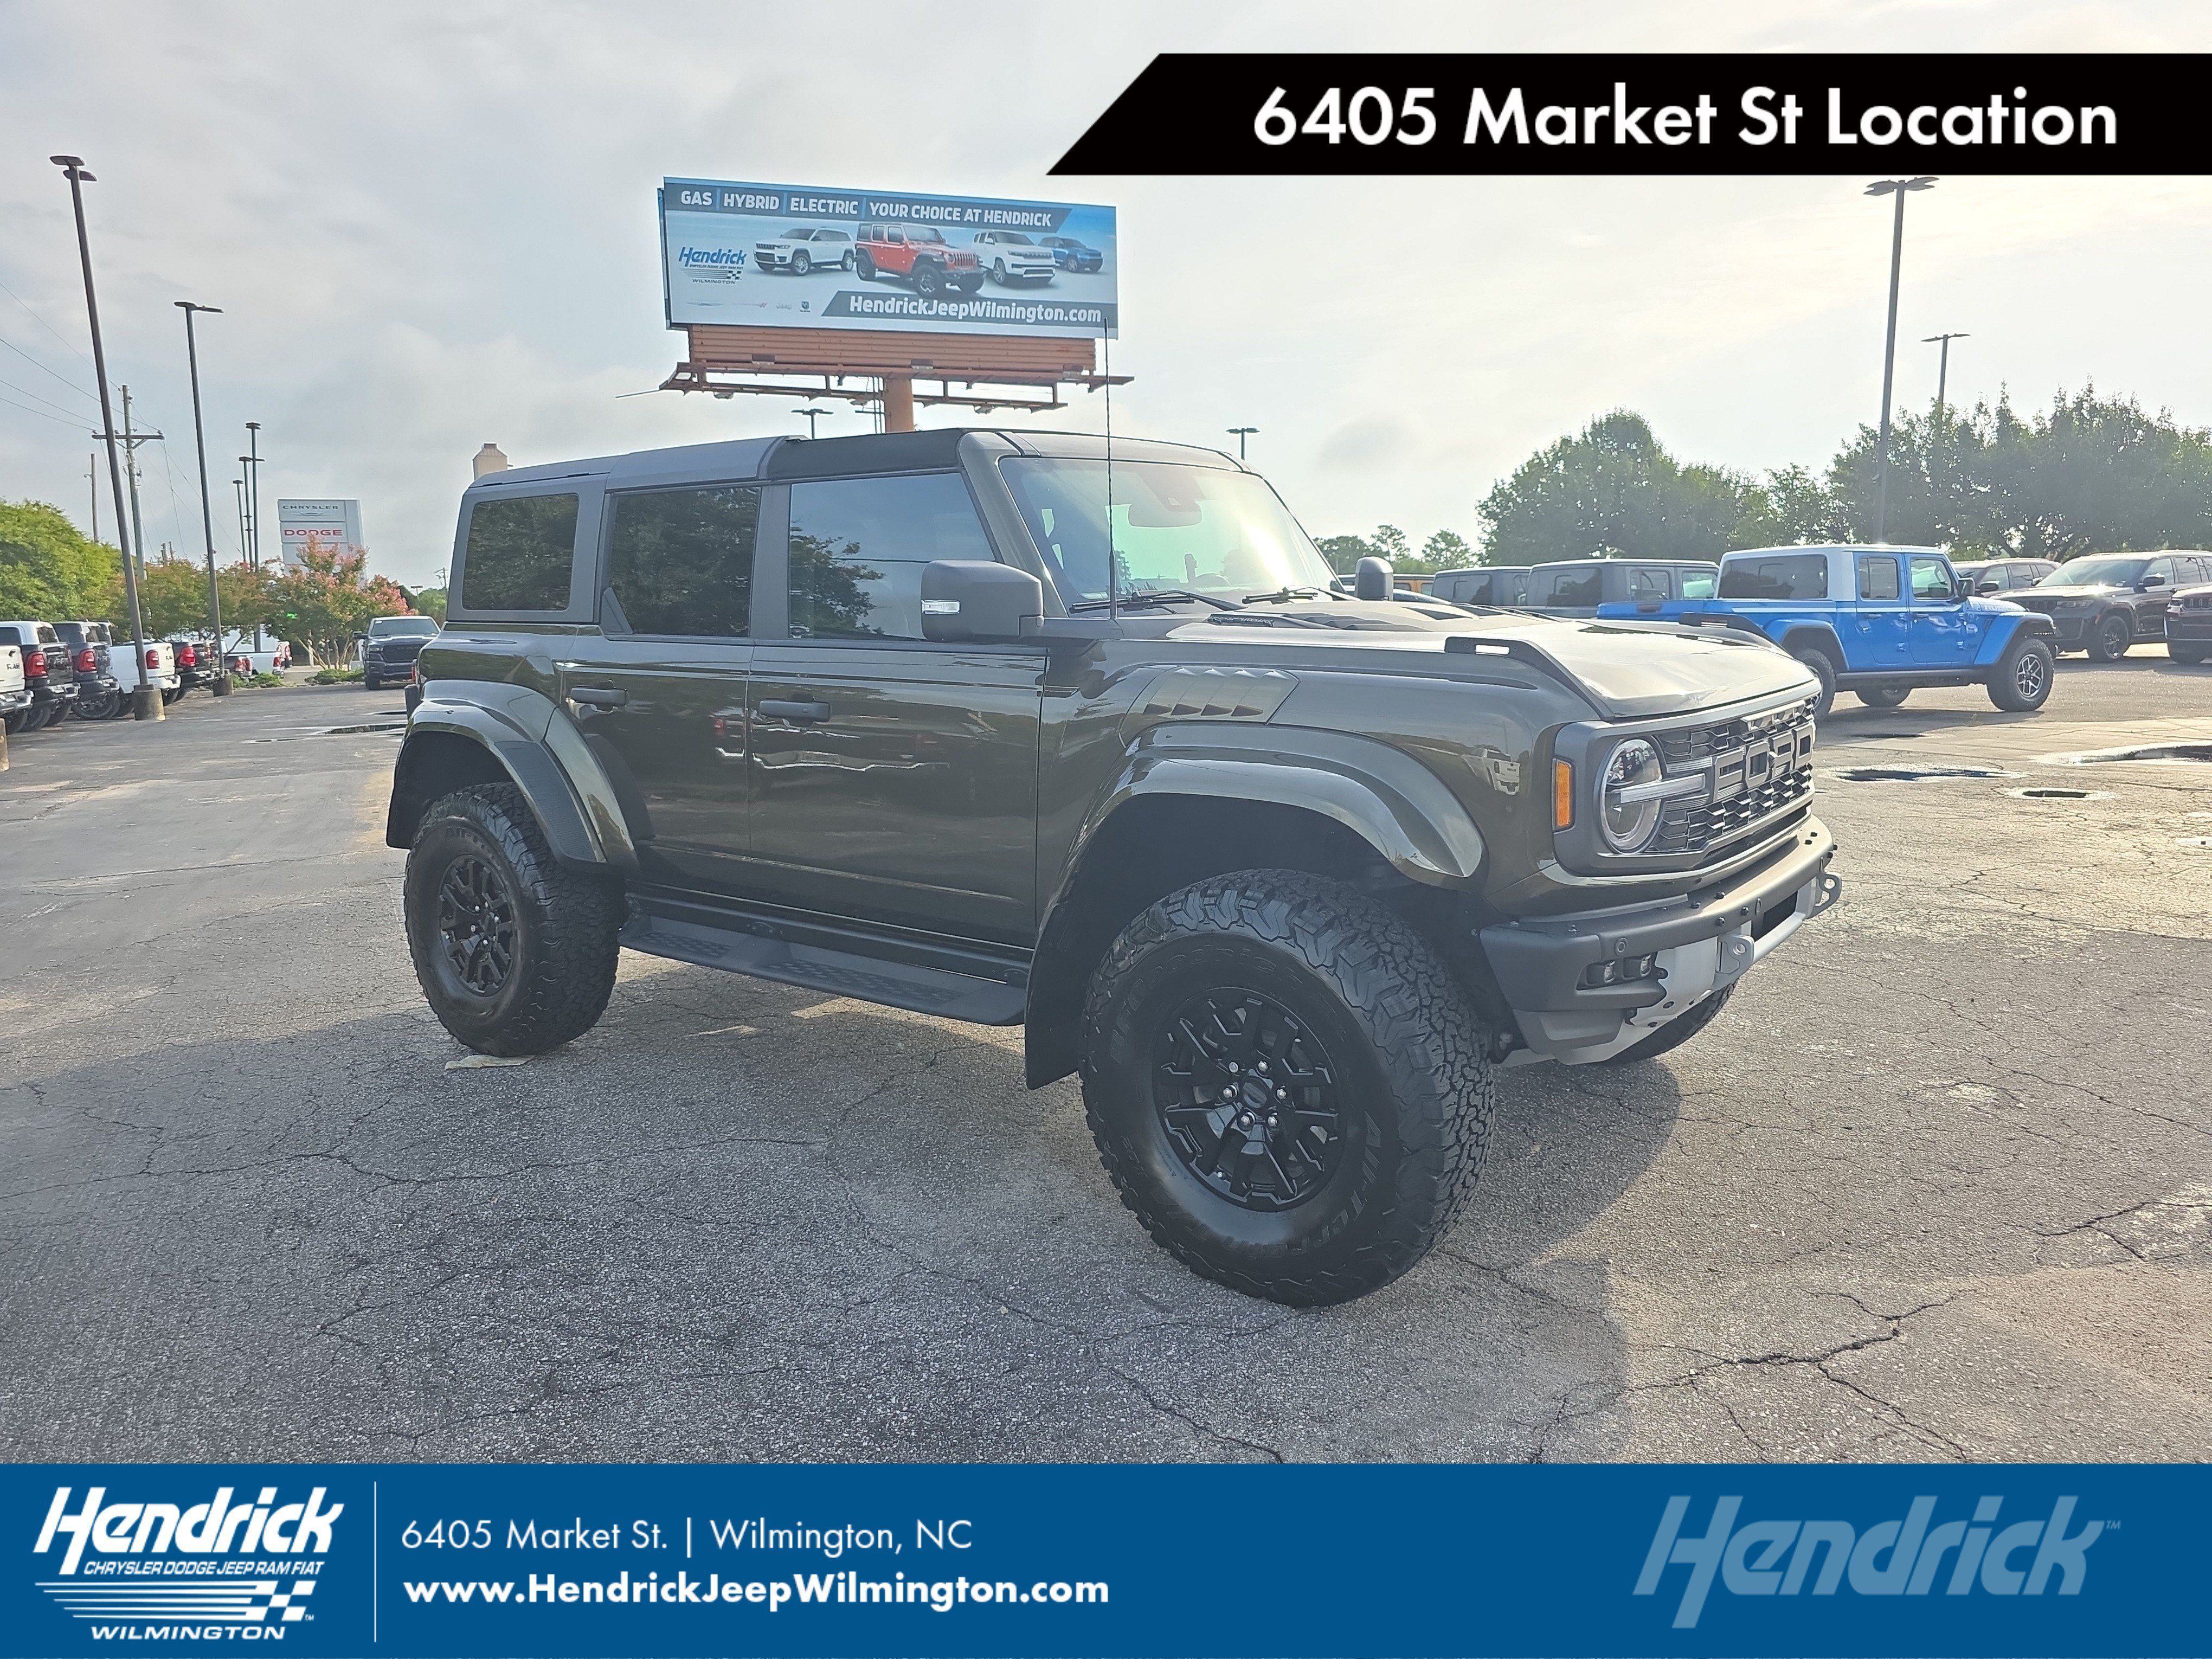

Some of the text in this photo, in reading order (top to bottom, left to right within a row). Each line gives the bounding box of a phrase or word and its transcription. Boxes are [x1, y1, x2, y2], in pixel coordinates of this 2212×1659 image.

[681, 190, 1051, 227] GAS HYBRID ELECTRIC YOUR CHOICE AT HENDRICK
[678, 247, 747, 267] Hendrick
[850, 296, 1101, 323] HendrickJeepWilmington.com
[1713, 722, 1816, 803] FORD
